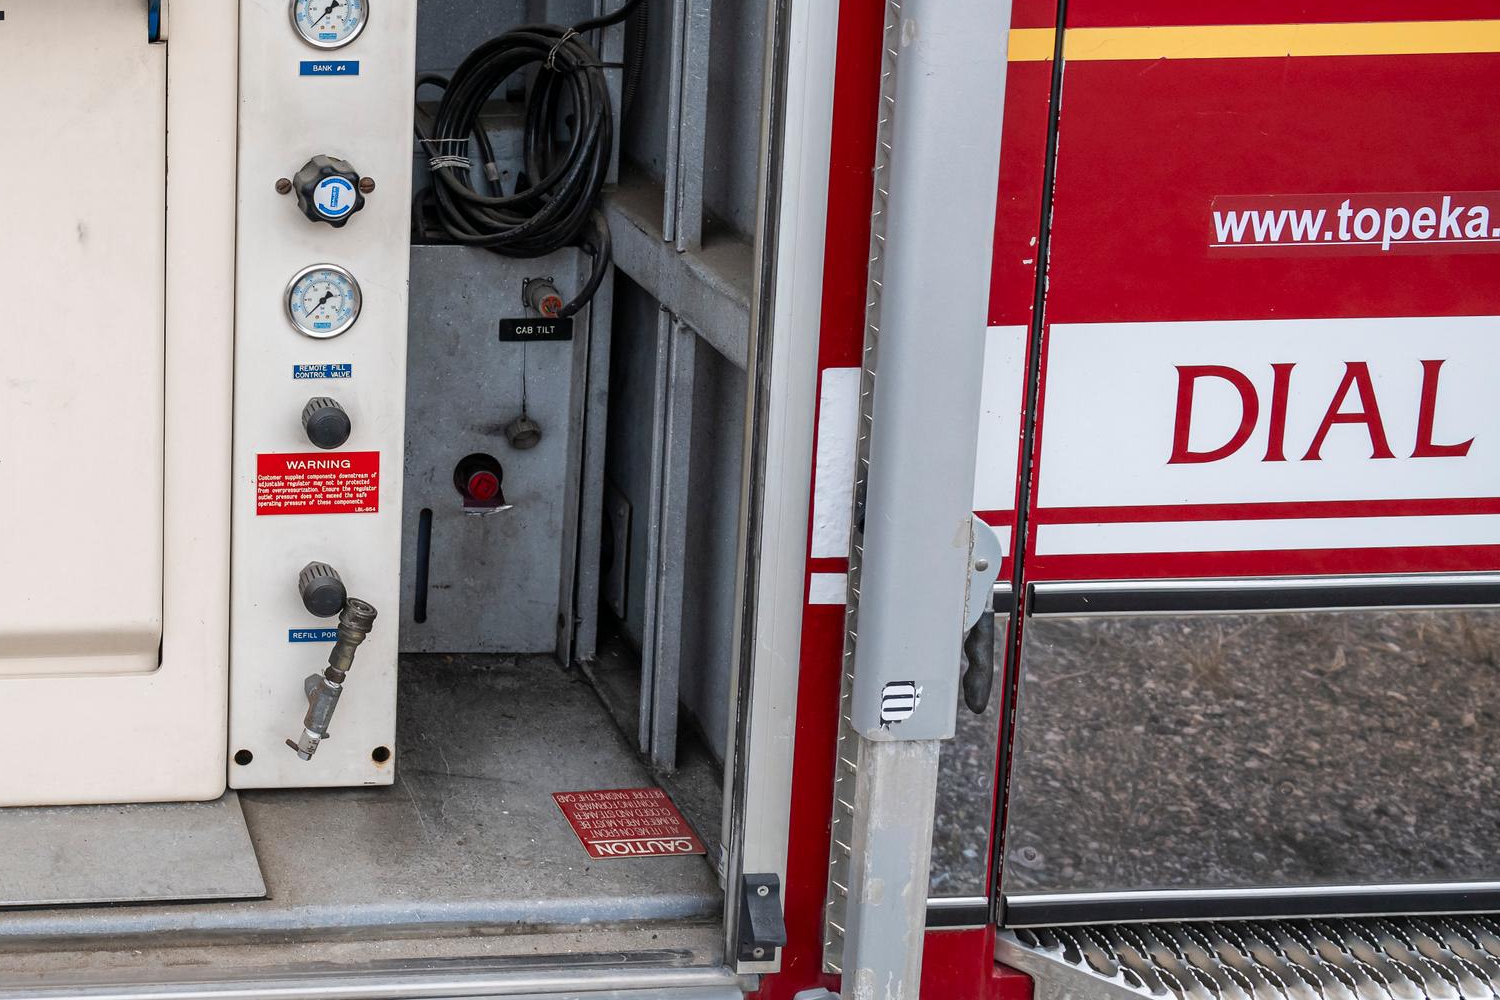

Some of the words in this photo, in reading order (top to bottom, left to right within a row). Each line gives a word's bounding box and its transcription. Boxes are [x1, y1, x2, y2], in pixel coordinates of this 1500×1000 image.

[1213, 196, 1500, 251] www.topeka.
[515, 325, 533, 335] CAB
[536, 325, 556, 334] TILT
[1167, 359, 1475, 464] DIAL
[286, 460, 351, 470] WARNING
[596, 840, 693, 855] CAUTION
